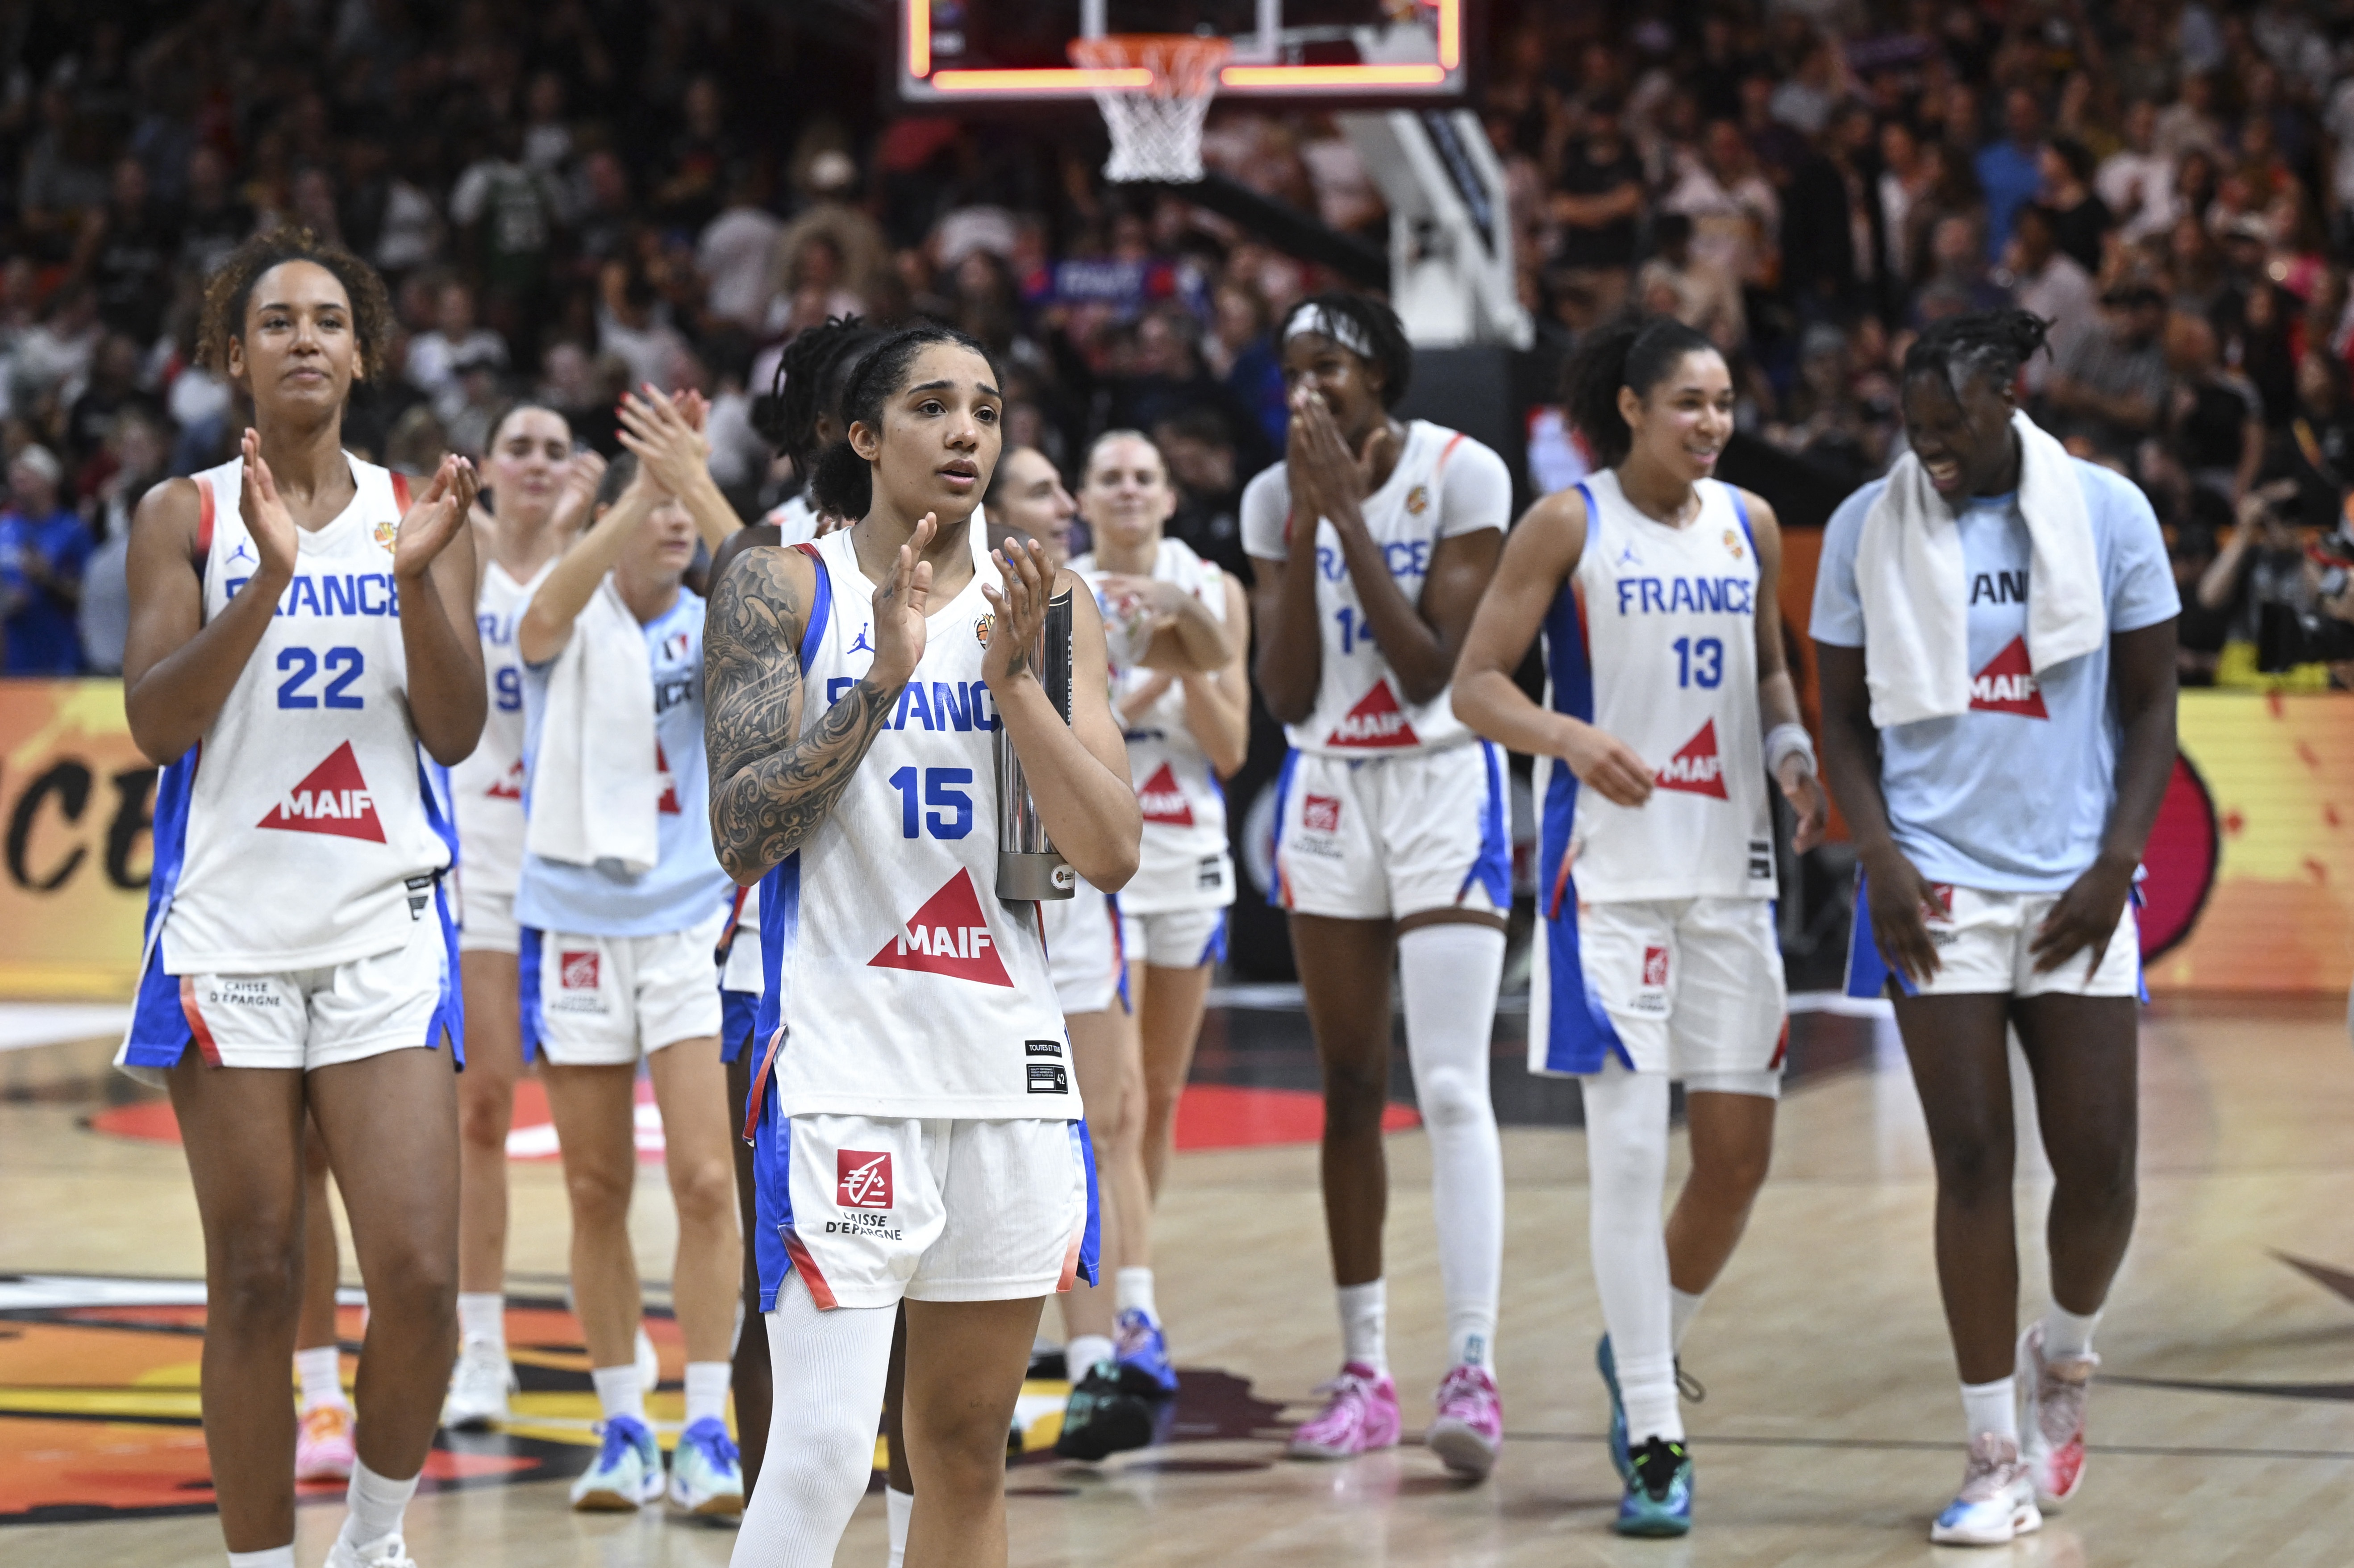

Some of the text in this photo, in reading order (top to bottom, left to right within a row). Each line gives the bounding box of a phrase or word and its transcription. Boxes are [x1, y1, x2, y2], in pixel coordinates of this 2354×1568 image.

[277, 647, 363, 709] 22
[1673, 637, 1723, 688] 13
[1338, 713, 1403, 741] MAIF
[280, 789, 372, 819] MAIF
[889, 766, 973, 840] 15
[897, 924, 991, 958] MAIF
[1057, 1073, 1065, 1085] 42
[825, 1221, 902, 1240] D'EPARGNE
